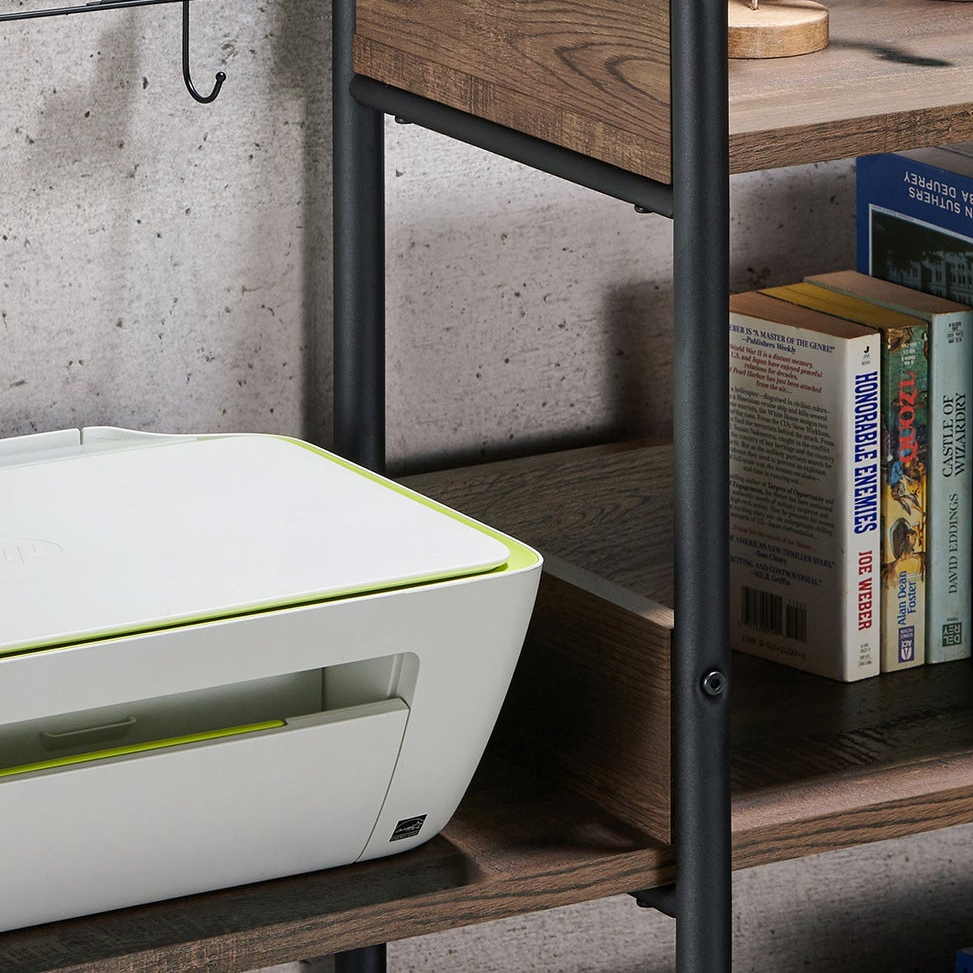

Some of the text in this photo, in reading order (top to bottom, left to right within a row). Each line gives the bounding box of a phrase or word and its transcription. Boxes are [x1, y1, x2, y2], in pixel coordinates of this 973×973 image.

[904, 171, 956, 199] DEUPREY
[909, 187, 961, 214] SUTHERS
[761, 330, 785, 343] MASTER
[854, 371, 878, 463] HONORABLE
[942, 395, 954, 478] CASTLE OF
[955, 393, 967, 477] WIZARDRY
[853, 464, 878, 534] ENEMIES
[948, 493, 959, 595] DAVID EDDINGS
[858, 550, 873, 576] JOE
[897, 570, 907, 599] Dean
[907, 581, 917, 616] Foster
[858, 577, 872, 631] WEBER
[897, 601, 907, 626] Alan
[943, 624, 961, 635] REY
[943, 634, 961, 645] DEL
